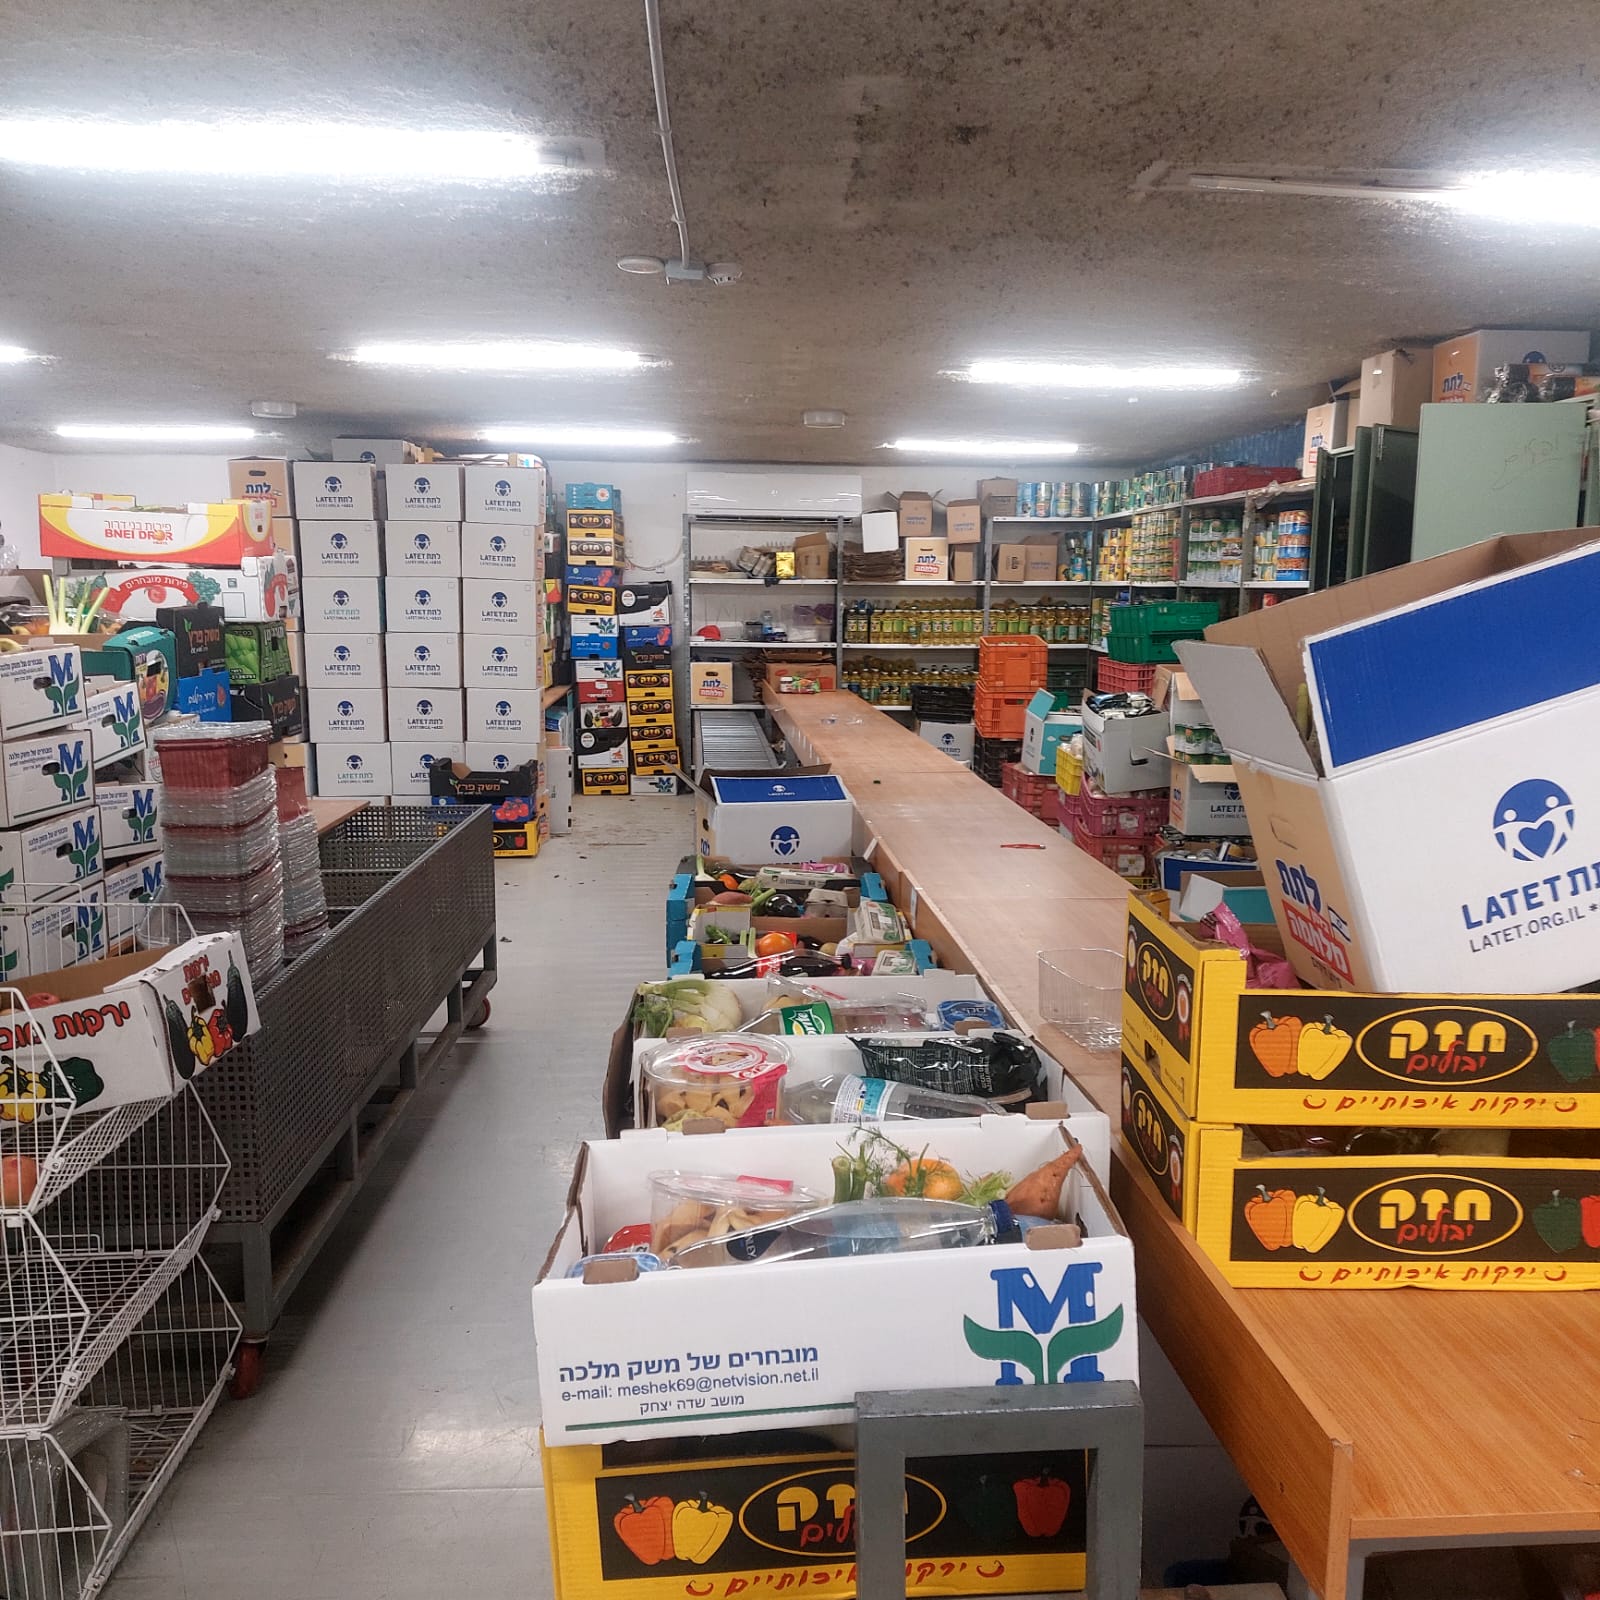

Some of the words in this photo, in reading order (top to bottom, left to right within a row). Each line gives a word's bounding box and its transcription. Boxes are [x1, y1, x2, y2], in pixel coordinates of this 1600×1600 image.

[245, 482, 271, 495] לתת
[104, 519, 126, 530] דרור
[104, 528, 135, 539] BNEI
[127, 520, 143, 530] בני
[145, 520, 172, 531] פירות
[917, 554, 936, 563] לתת
[125, 576, 162, 590] מובחרים
[163, 578, 189, 589] פירות
[702, 679, 721, 688] לתת
[454, 784, 475, 794] פרץ
[478, 784, 500, 794] משק
[1211, 805, 1237, 813] LATET
[1275, 859, 1321, 913] לתת
[1462, 875, 1562, 930] LATET
[1469, 906, 1586, 953] LATET.ORG.IL
[1287, 911, 1349, 974] מלחמה
[1142, 949, 1169, 999] חזק
[52, 1001, 131, 1040] ירקות
[1389, 1019, 1507, 1060] חזק
[1405, 1039, 1487, 1073] יבולים
[1334, 1096, 1459, 1112] איכותיים
[1468, 1096, 1547, 1112] ירקות
[1138, 1097, 1162, 1153] חזק
[1379, 1188, 1491, 1230] חזק
[1396, 1209, 1474, 1244] יבולים
[1331, 1266, 1451, 1284] איכותיים
[1461, 1266, 1537, 1283] ירקות
[990, 1262, 1104, 1386] M
[686, 1352, 721, 1371] של
[729, 1346, 819, 1368] מובחרים
[559, 1361, 620, 1382] מלכה
[626, 1357, 681, 1381] משק
[561, 1386, 613, 1402] e-mail:
[617, 1369, 819, 1397] meshek69@netvision.net.il
[639, 1399, 672, 1416] יצחק
[677, 1397, 706, 1410] שדה
[710, 1393, 745, 1408] מושב
[905, 1561, 967, 1586] ירקו
